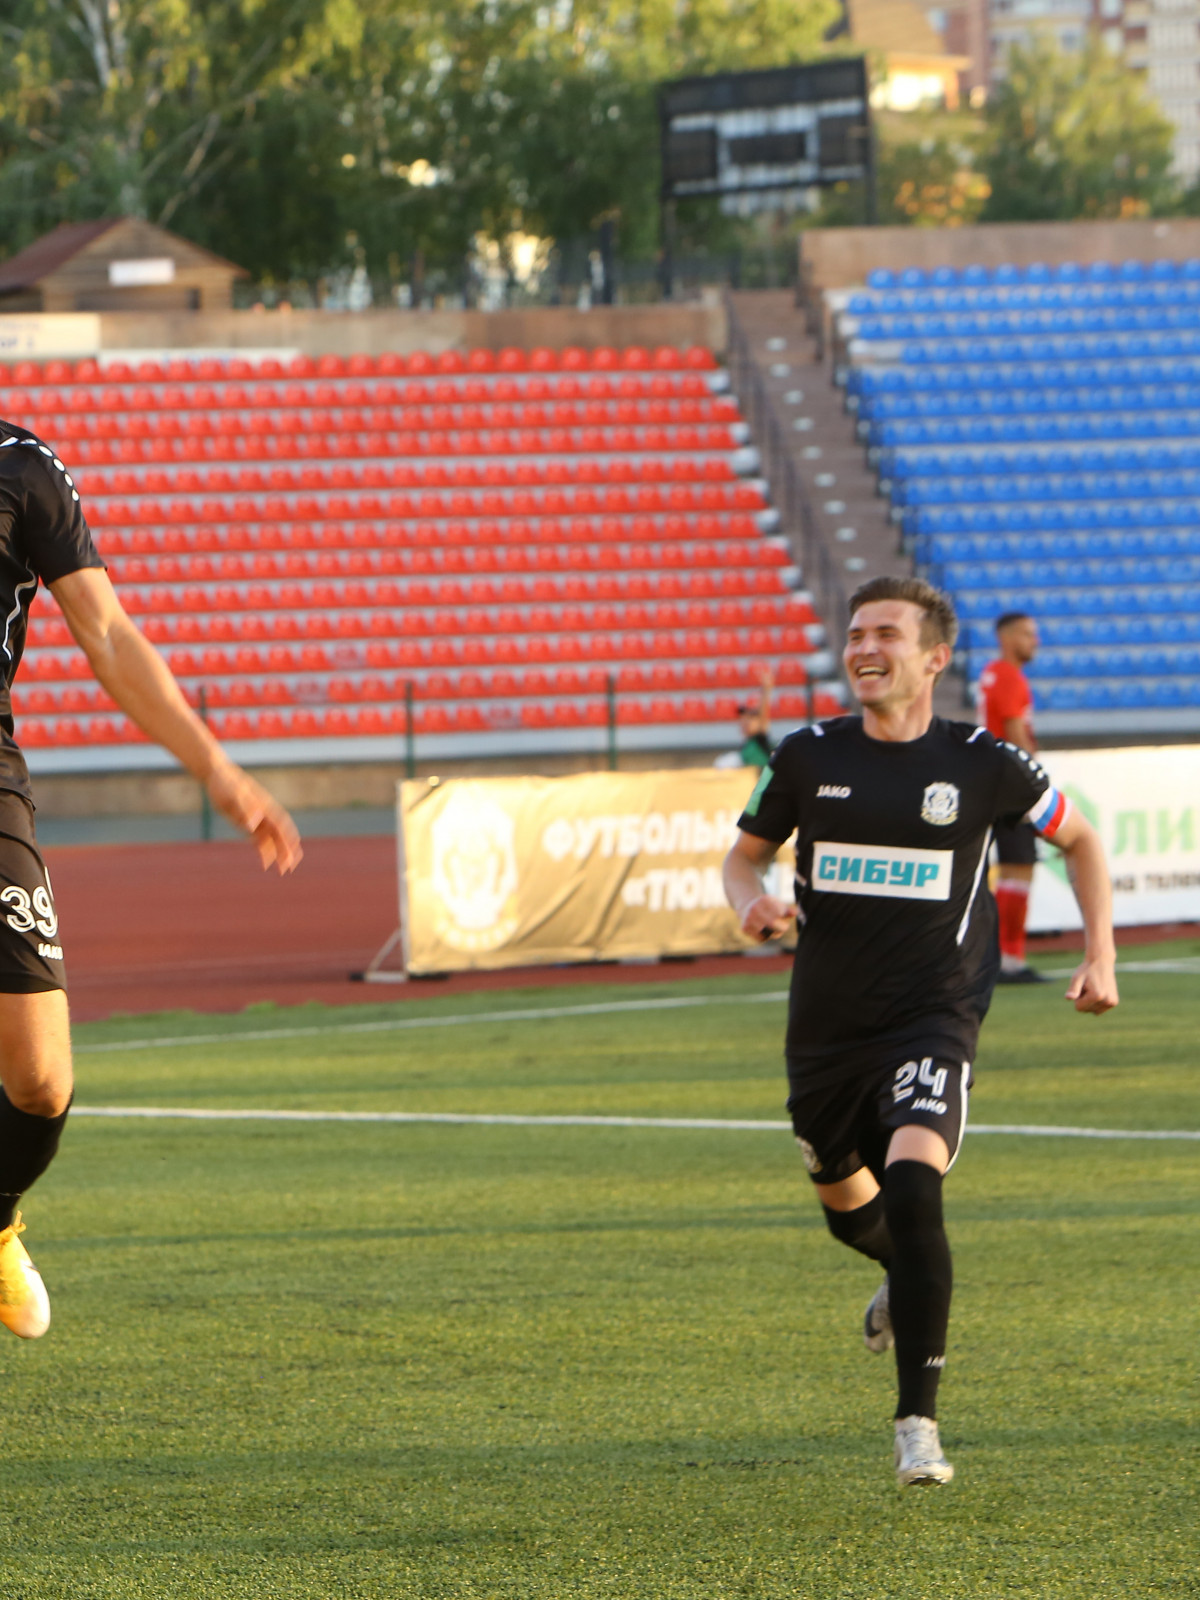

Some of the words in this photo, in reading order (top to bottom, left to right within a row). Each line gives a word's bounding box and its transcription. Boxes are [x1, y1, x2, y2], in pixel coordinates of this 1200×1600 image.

[816, 784, 852, 799] JAKO
[543, 810, 740, 860] ФУТБОЛЬН
[818, 854, 940, 888] СИБУР
[0, 885, 59, 938] 39
[891, 1056, 949, 1104] 24
[911, 1097, 949, 1116] JAKO
